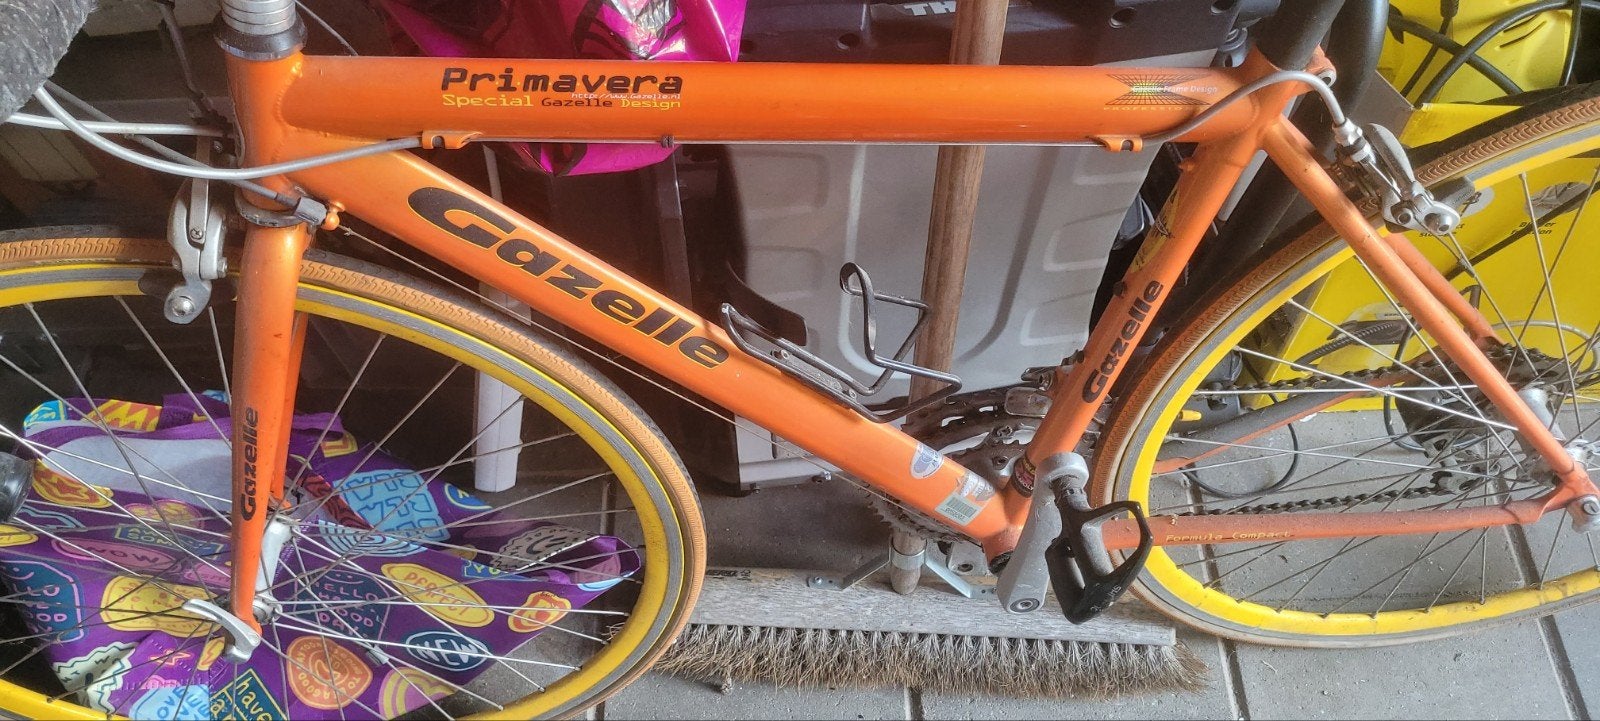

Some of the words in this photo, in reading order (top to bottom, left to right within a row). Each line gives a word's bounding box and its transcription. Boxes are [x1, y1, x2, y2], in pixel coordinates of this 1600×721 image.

[441, 67, 683, 93] Primavera
[1190, 86, 1218, 95] Design
[442, 94, 534, 108] Special
[541, 97, 613, 107] Gazelle
[620, 97, 681, 110] Design
[407, 187, 730, 369] Gazelle
[1082, 280, 1164, 404] Gazelle
[241, 407, 258, 521] Gazelle
[1166, 533, 1223, 542] Formula
[1232, 531, 1291, 541] Compact
[416, 639, 479, 666] NEW
[234, 676, 273, 721] have
